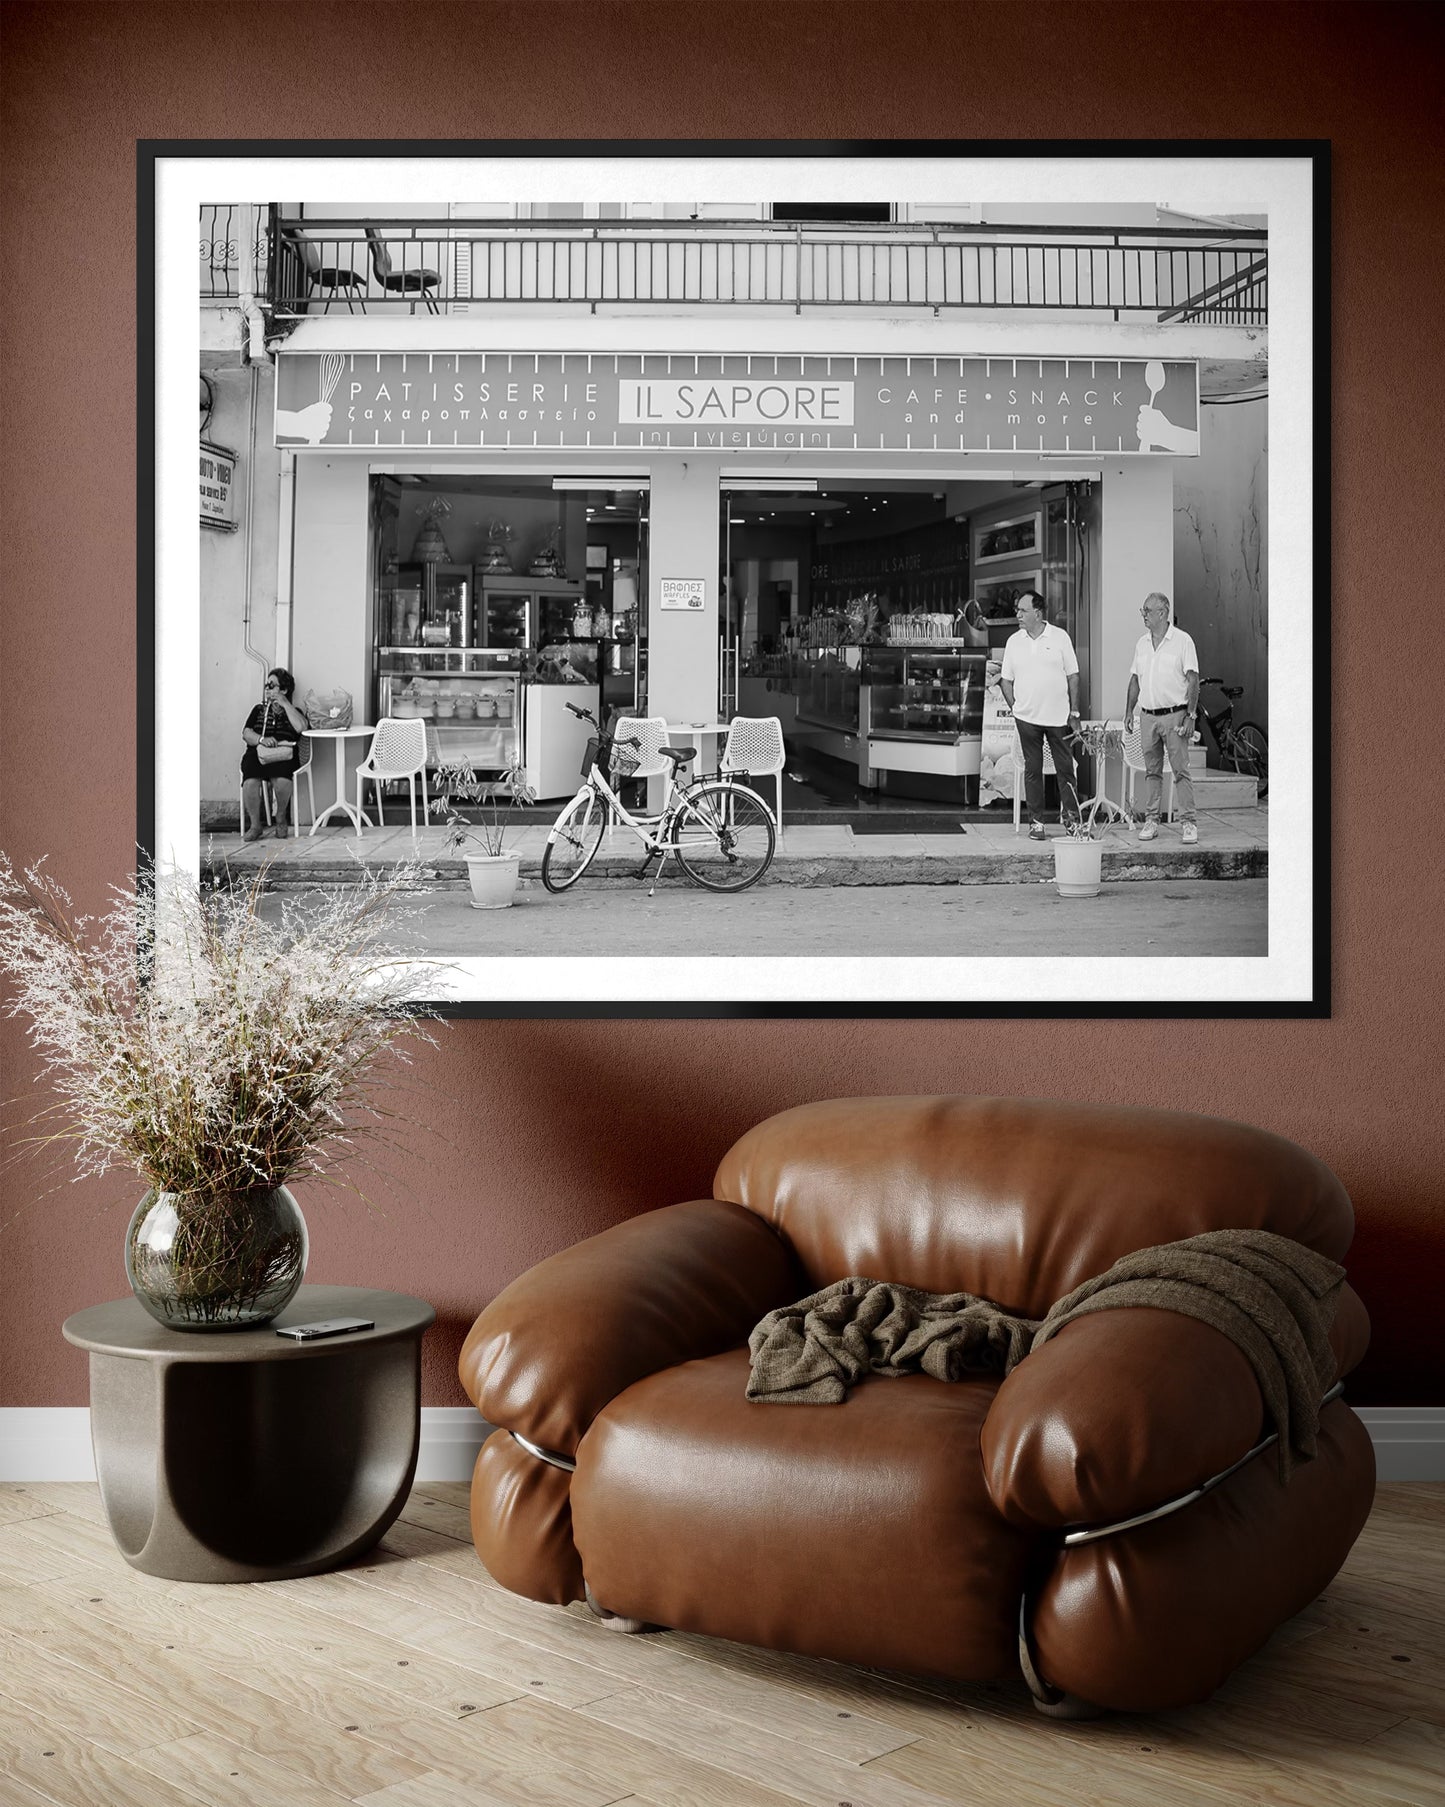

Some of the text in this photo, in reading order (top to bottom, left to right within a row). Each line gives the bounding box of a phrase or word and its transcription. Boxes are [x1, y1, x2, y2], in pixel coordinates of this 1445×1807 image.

[350, 382, 597, 402] PATISSERIE
[877, 387, 1123, 406] CAFE SNACK
[636, 385, 840, 420] IL SAPORE
[347, 407, 597, 422] ζαχαροπλαστείο
[904, 410, 1093, 425] and more
